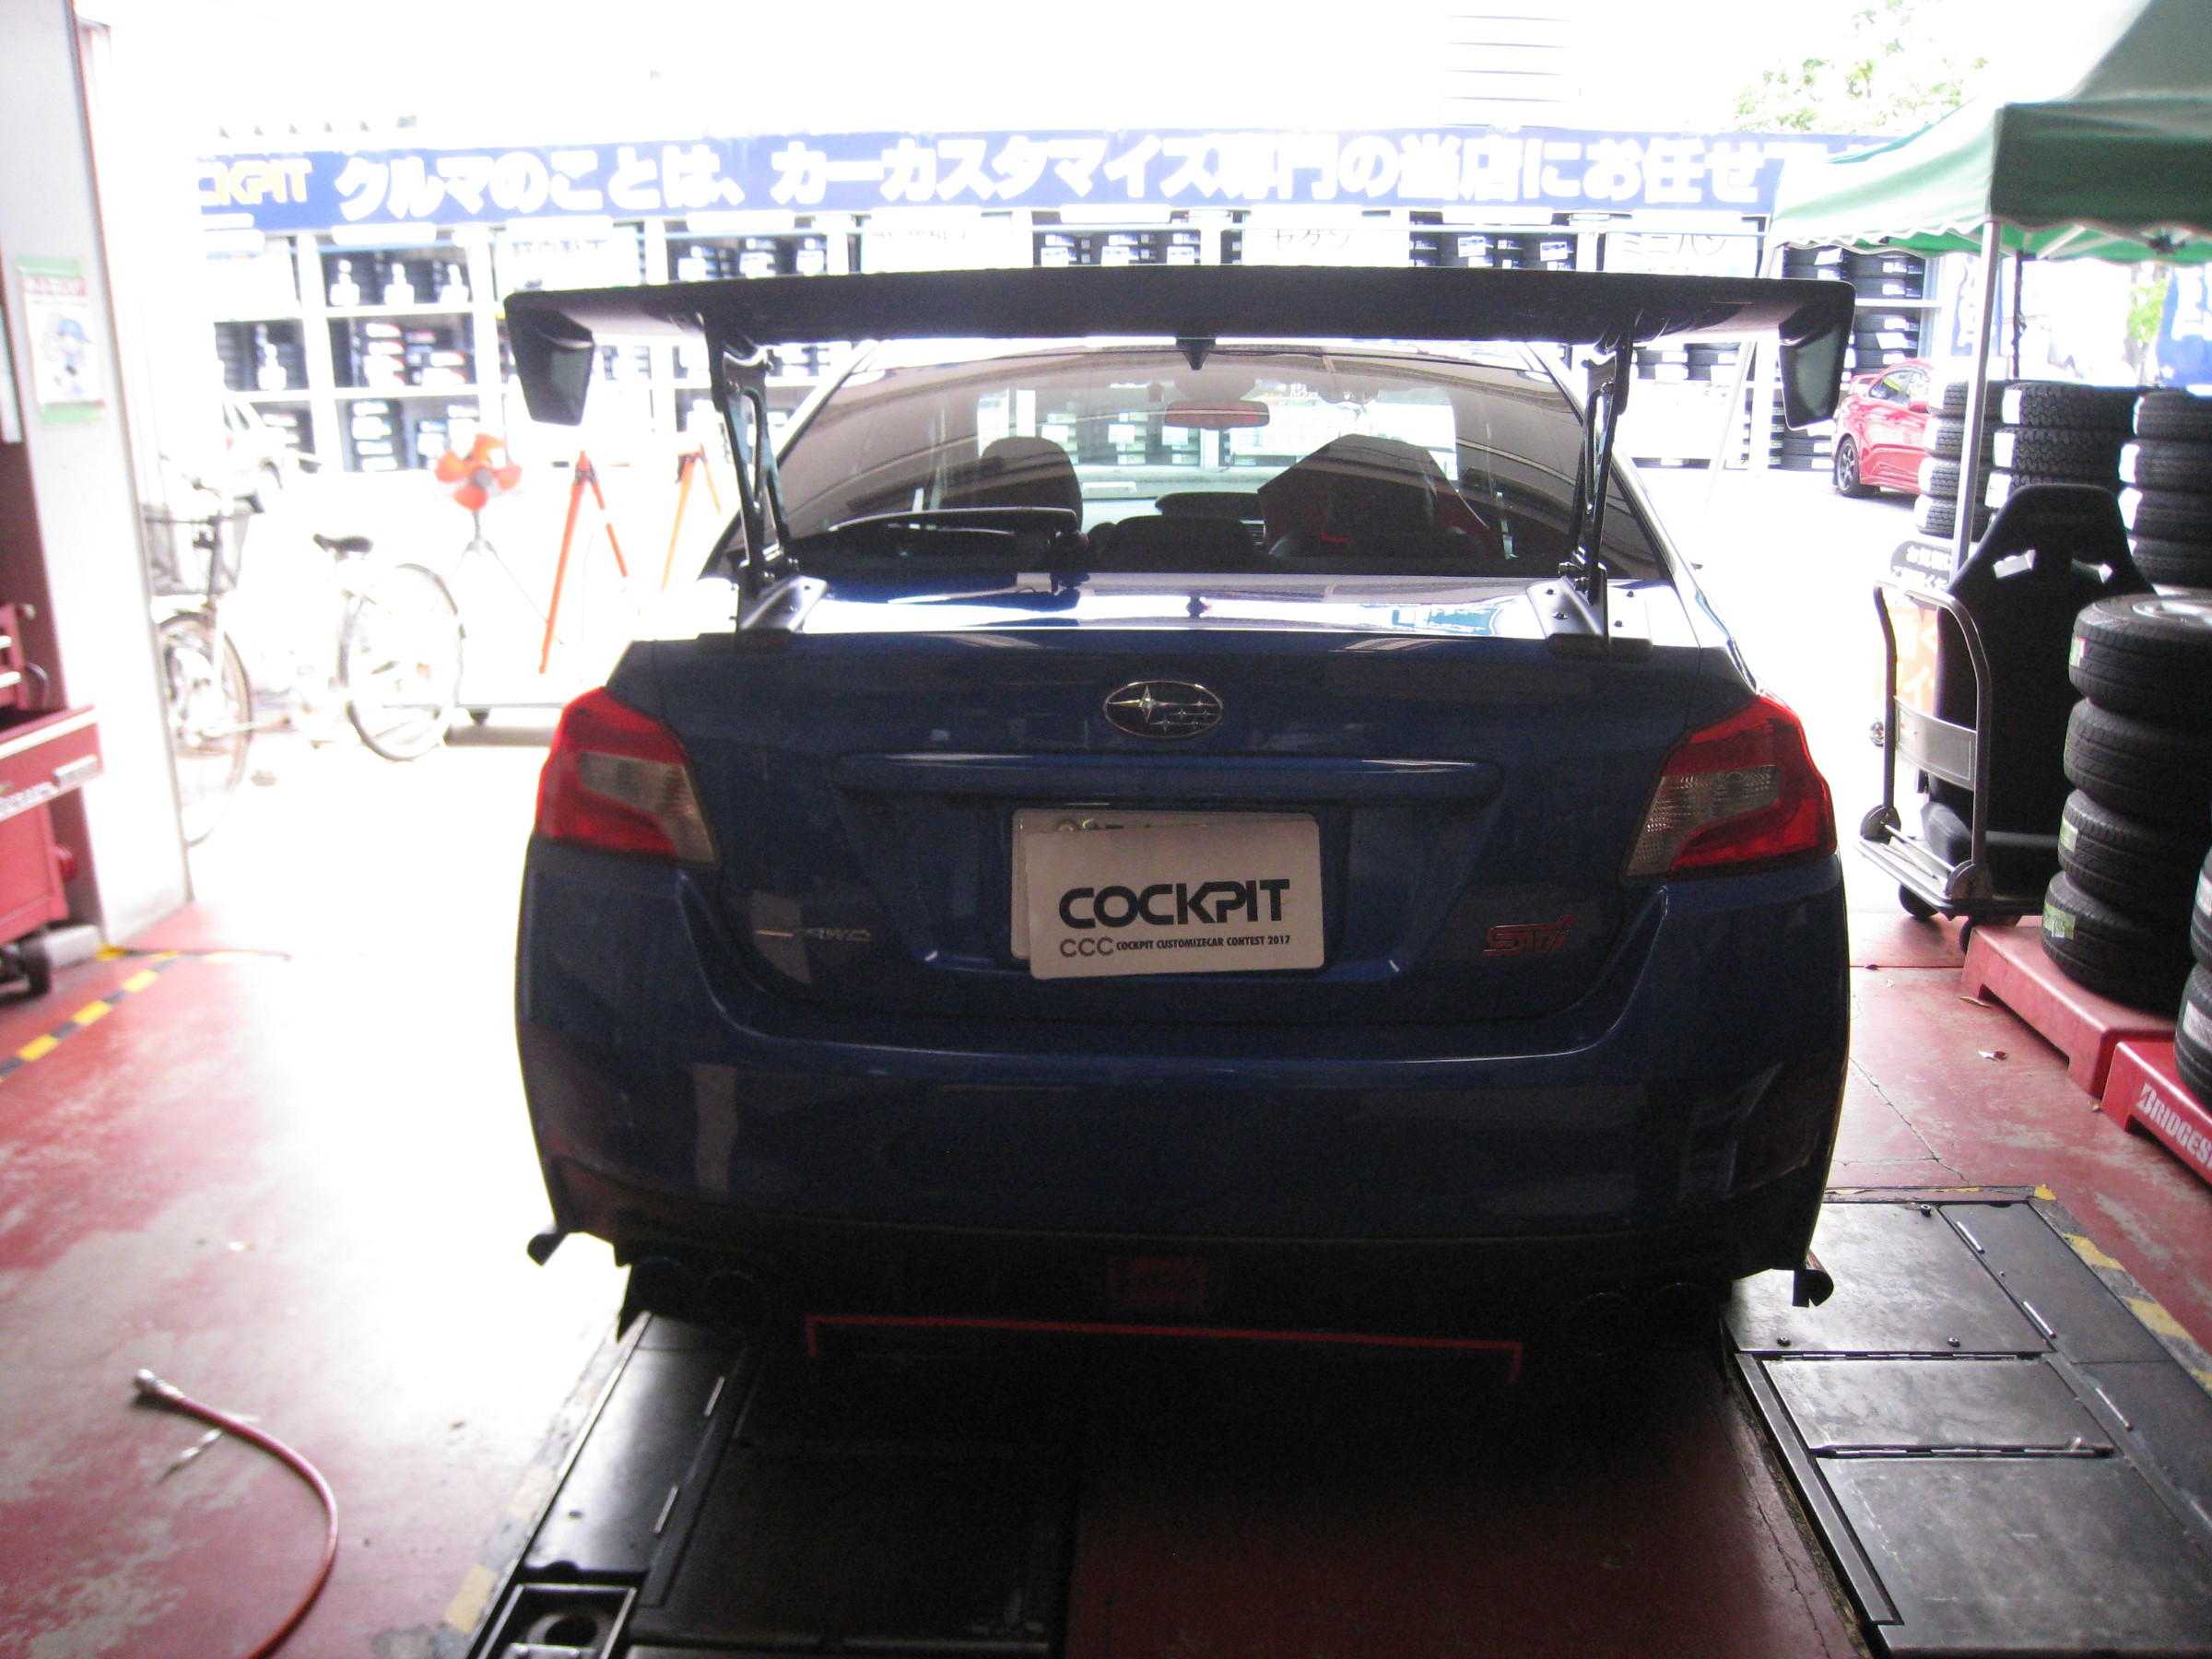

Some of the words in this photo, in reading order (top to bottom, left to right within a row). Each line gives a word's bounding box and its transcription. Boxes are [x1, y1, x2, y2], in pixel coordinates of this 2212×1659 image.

[1059, 878, 1290, 929] COCKPIT
[1060, 936, 1114, 959] CCC
[1116, 940, 1154, 951] COCKPIT
[1156, 936, 1224, 950] CUSTOMIZECAR
[1227, 935, 1265, 947] CONTEST
[1269, 935, 1291, 945] 2017
